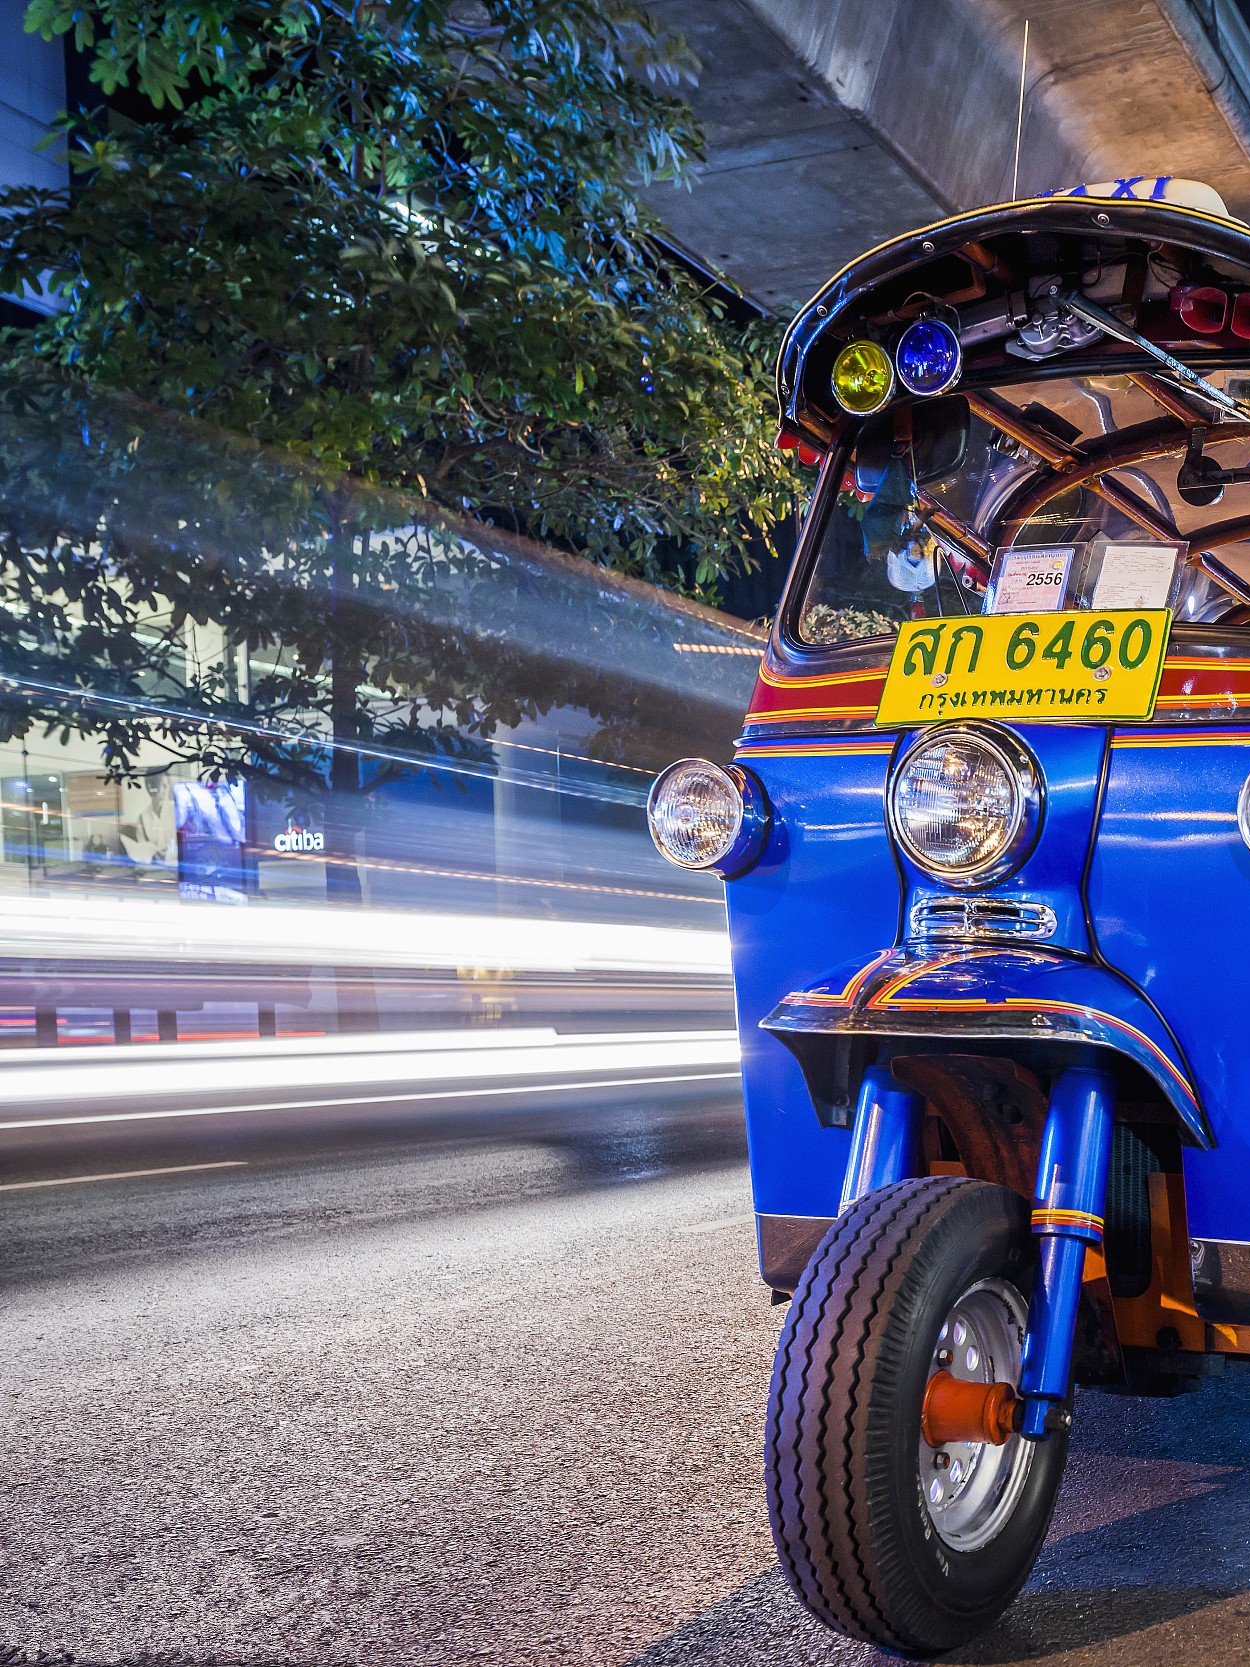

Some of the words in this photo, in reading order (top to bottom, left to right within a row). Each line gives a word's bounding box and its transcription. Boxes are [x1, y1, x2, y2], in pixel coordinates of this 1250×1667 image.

[1026, 571, 1063, 587] 2556
[903, 623, 984, 676] สก
[1006, 618, 1153, 671] 6460
[918, 687, 1108, 716] กรุงเทพมหานคร
